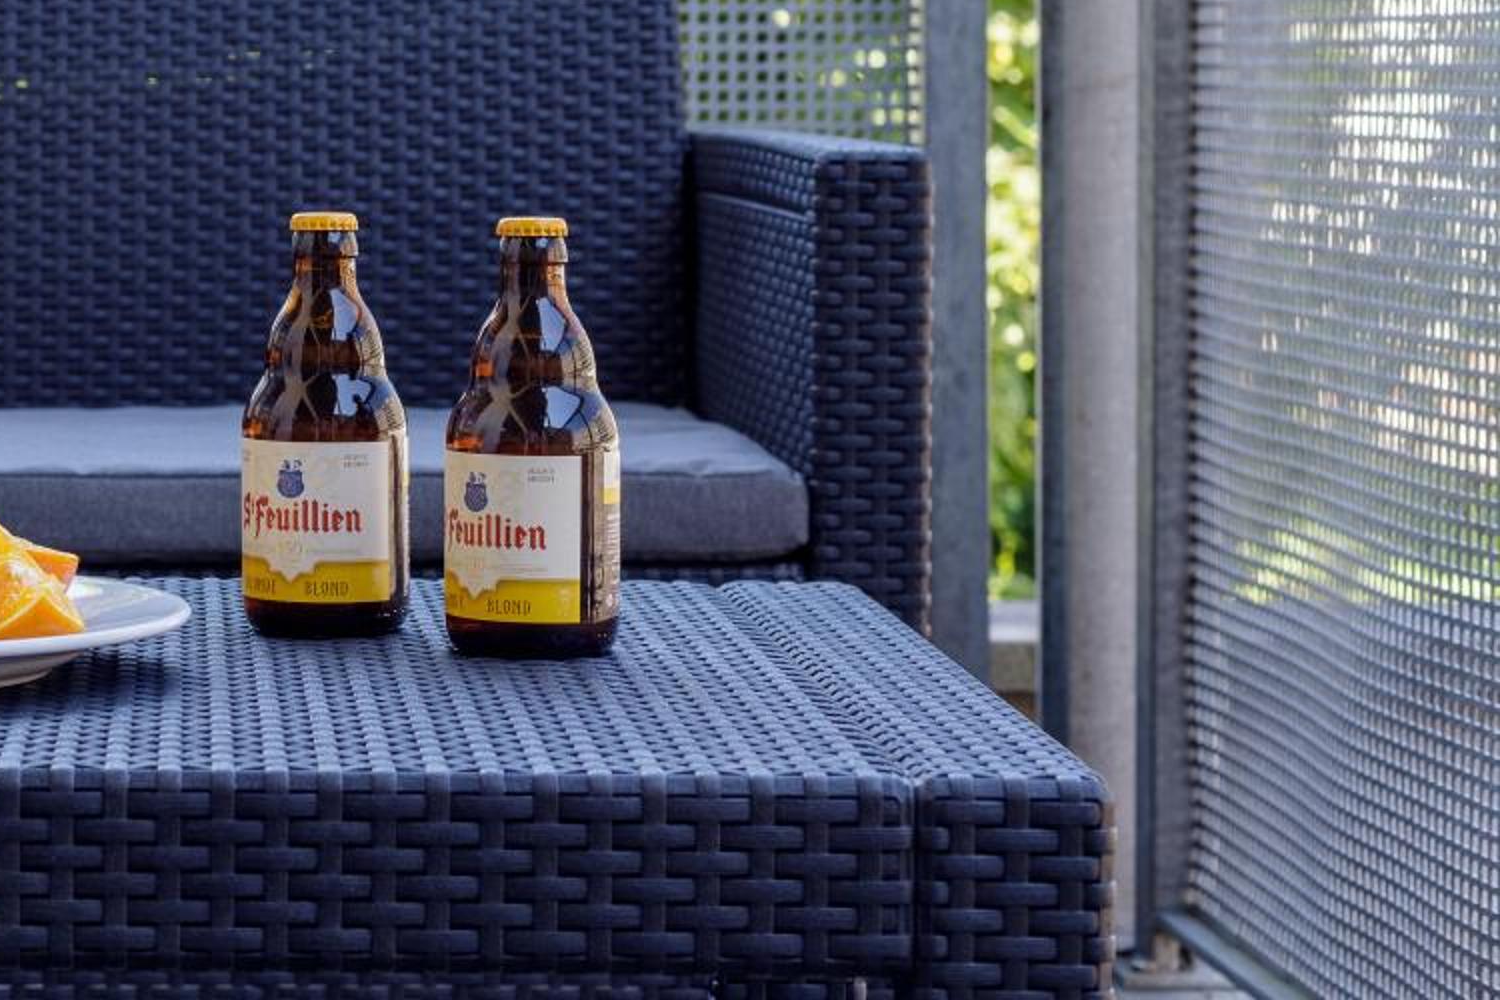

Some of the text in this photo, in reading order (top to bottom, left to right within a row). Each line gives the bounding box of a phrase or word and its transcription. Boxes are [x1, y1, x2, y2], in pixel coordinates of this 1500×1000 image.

[256, 496, 362, 538] Feuillien
[304, 580, 349, 597] BLOND
[486, 598, 532, 616] BLOND
